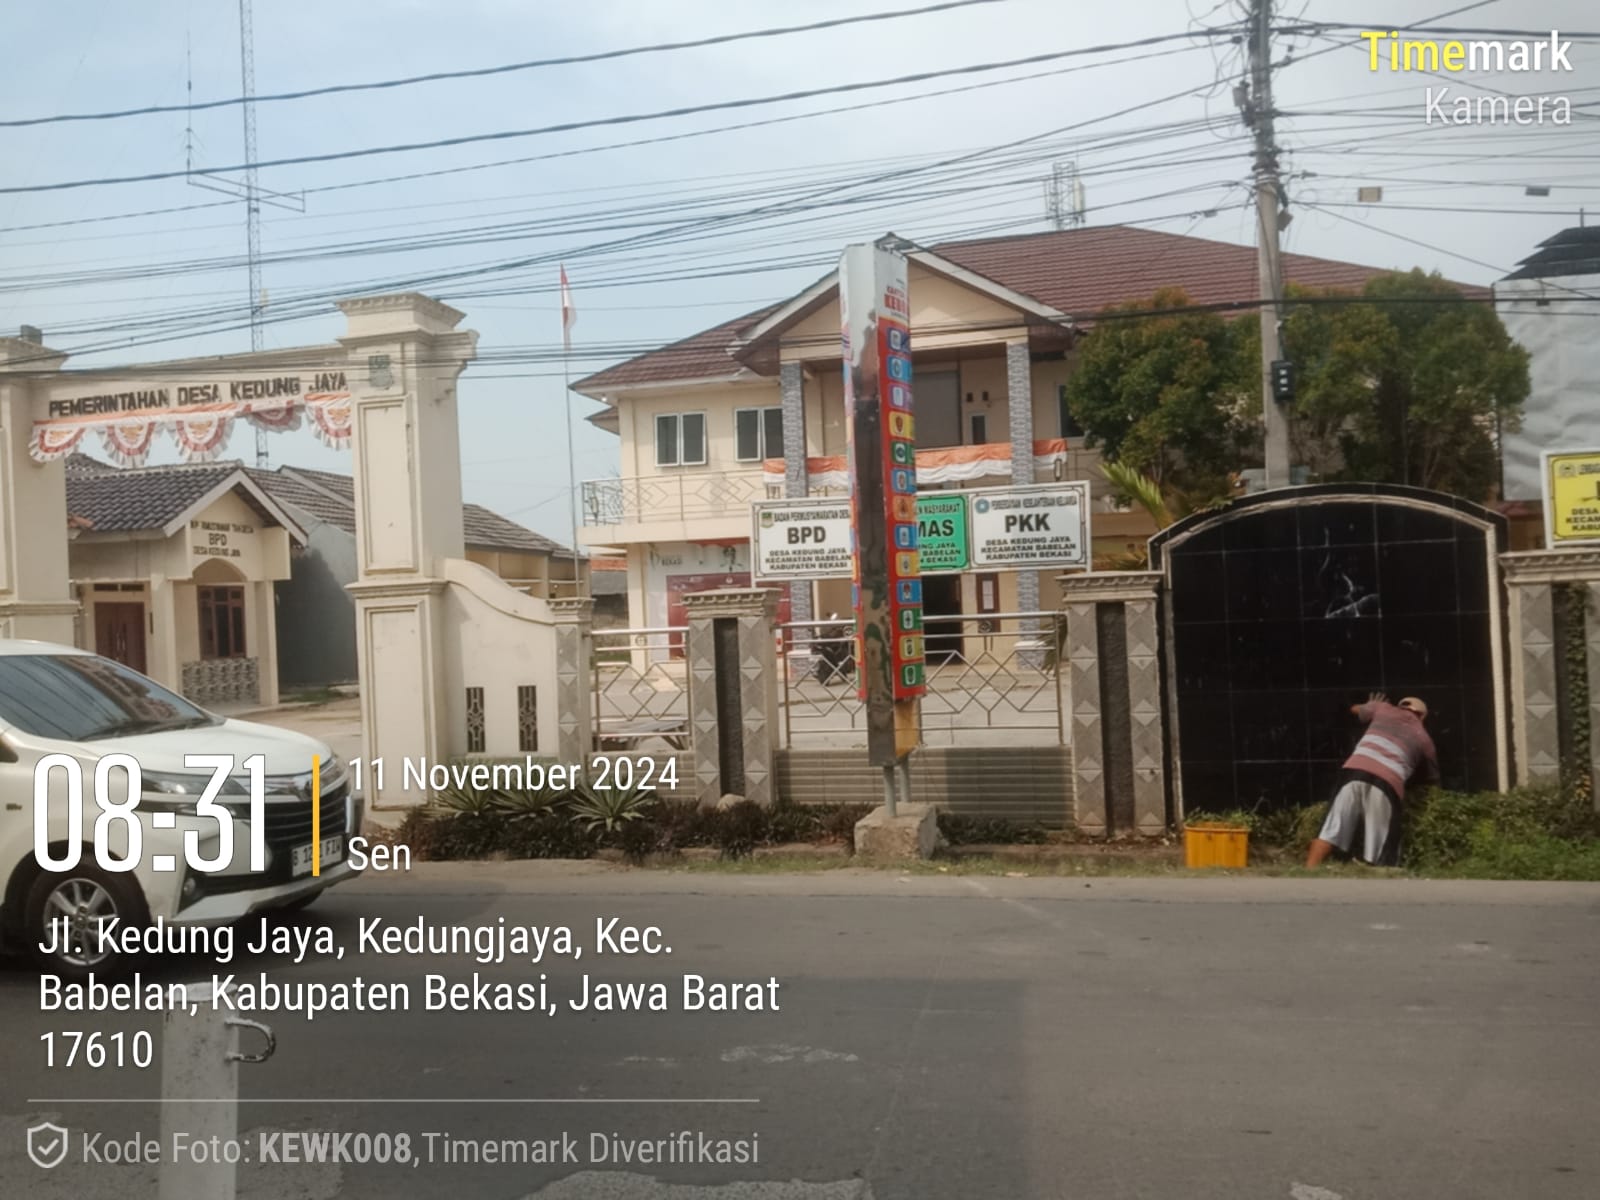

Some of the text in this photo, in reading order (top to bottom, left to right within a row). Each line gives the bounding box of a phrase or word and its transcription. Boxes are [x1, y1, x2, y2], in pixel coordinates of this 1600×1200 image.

[49, 372, 348, 417] PEMERINTAHAN DESA KEDUNG JAYA
[1004, 513, 1051, 533] PKK
[208, 532, 228, 547] BPD
[787, 526, 826, 545] BPD
[1010, 537, 1047, 545] KEDUNG
[1049, 535, 1071, 543] JAYA
[791, 548, 824, 556] KEDUNG
[827, 547, 847, 555] JAYA
[922, 549, 961, 557] BABELAN
[981, 543, 1076, 553] KECAMATAN BABELAN
[814, 554, 851, 562] BABELAN
[986, 550, 1072, 560] KABUPATEN BEKASI
[818, 561, 848, 569] BEKASI
